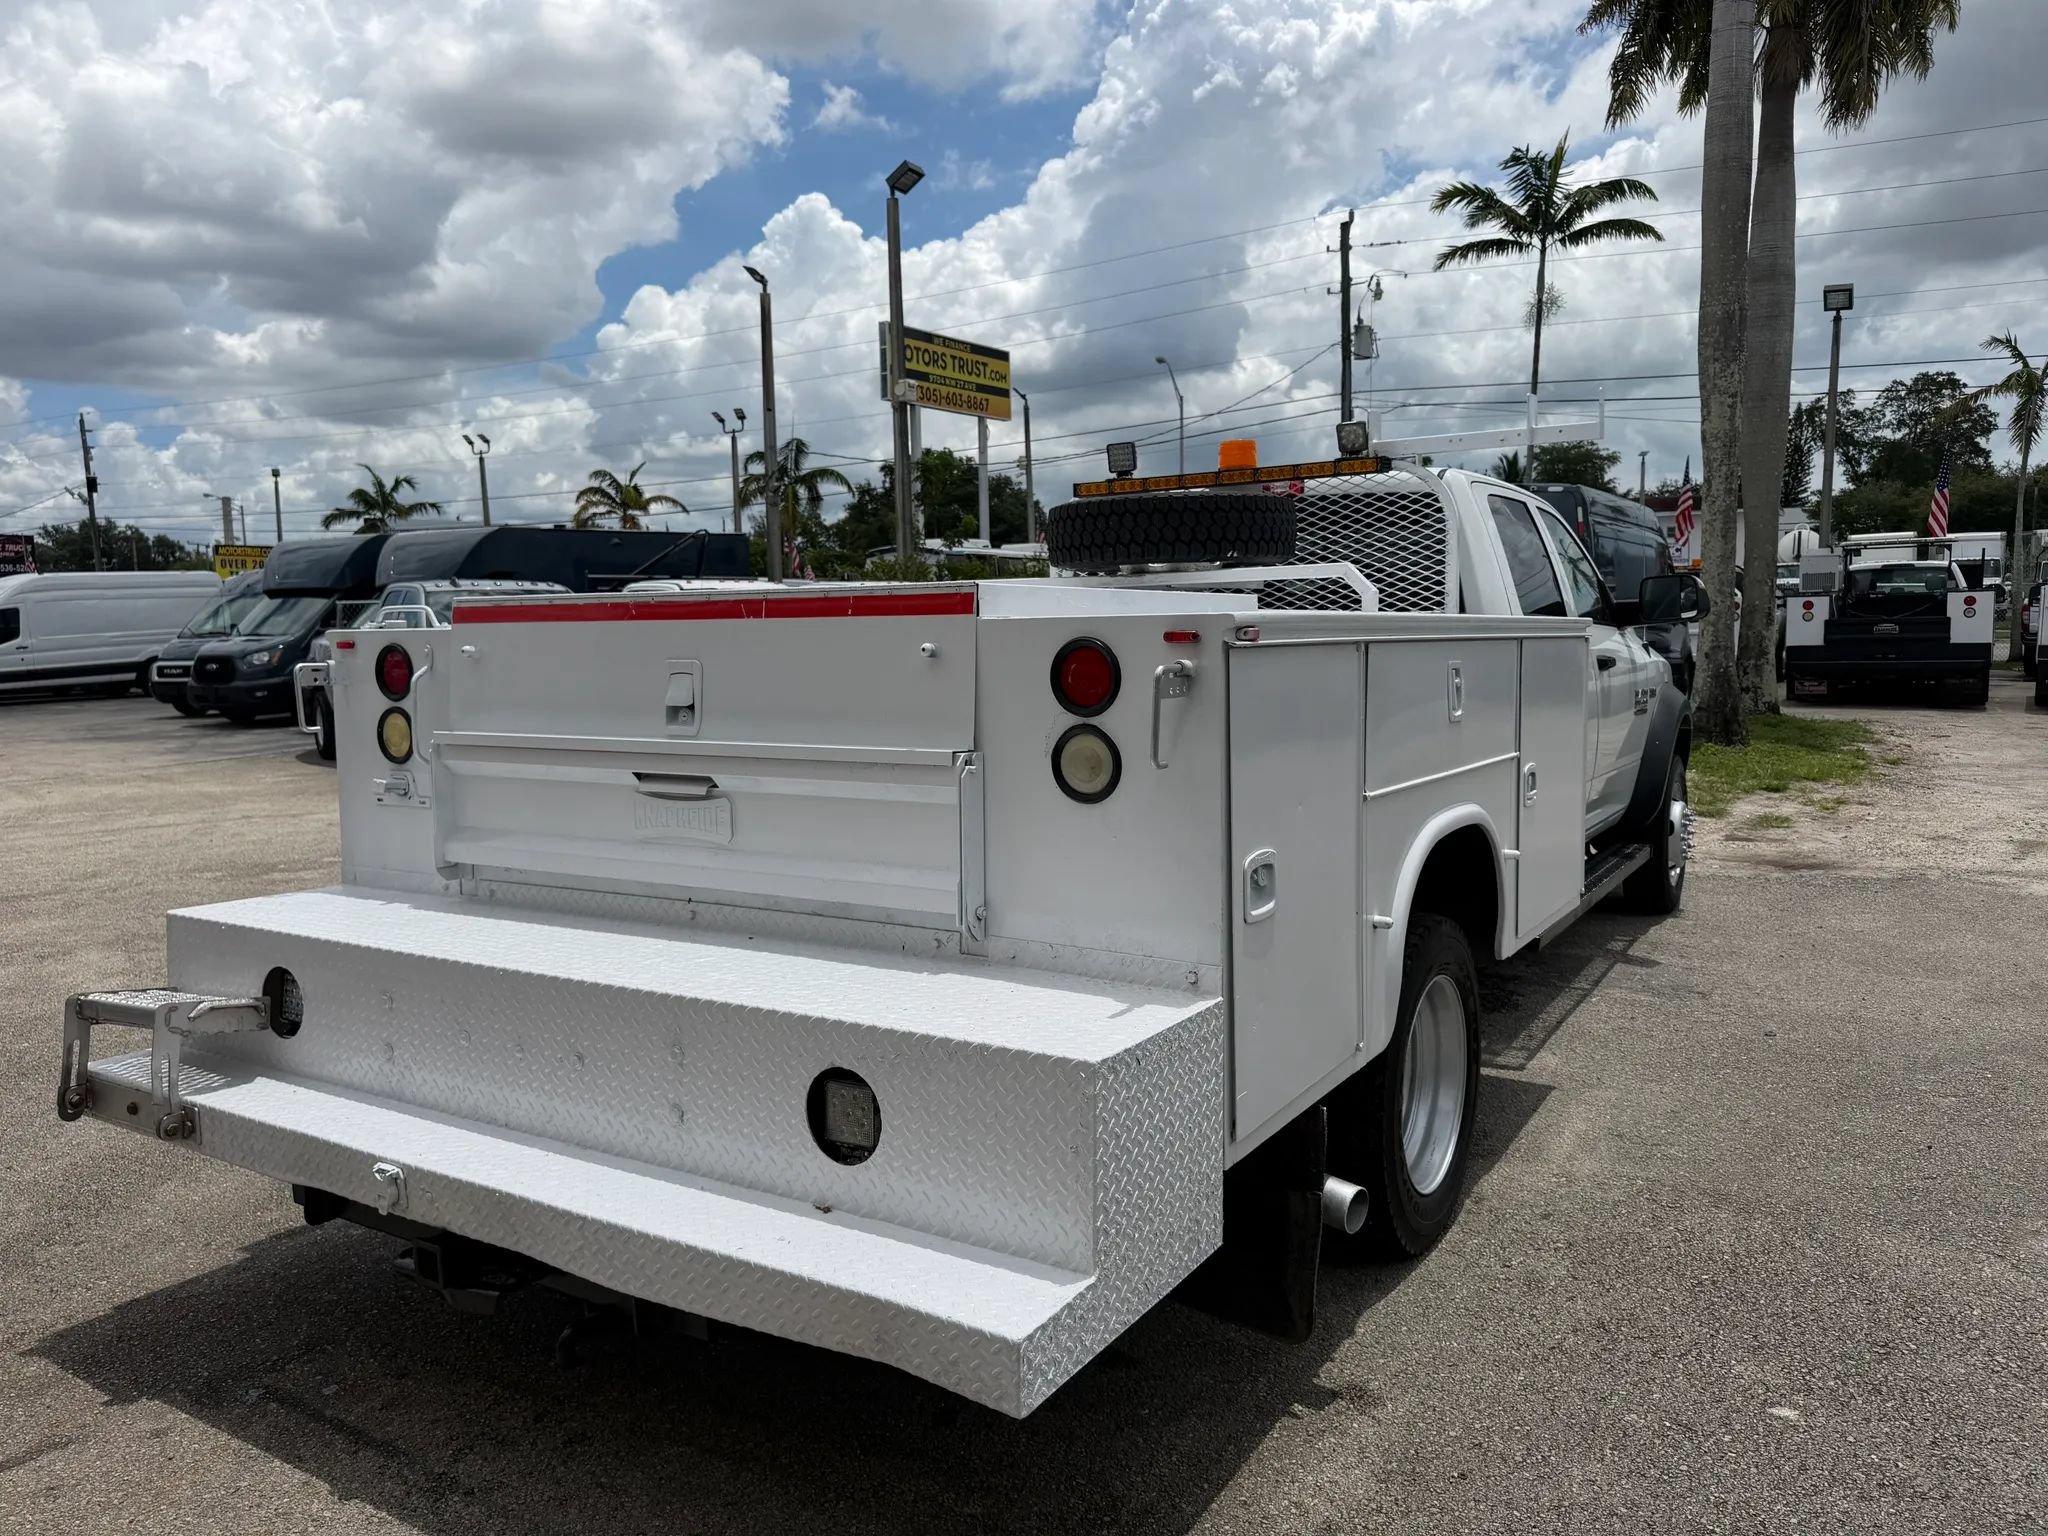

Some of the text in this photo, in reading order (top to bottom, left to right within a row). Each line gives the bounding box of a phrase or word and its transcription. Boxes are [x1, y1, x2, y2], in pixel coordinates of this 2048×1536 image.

[904, 344, 1007, 383] OTORS TRUST.COM
[916, 384, 989, 412] (305)-603-8867
[221, 559, 247, 569] OVER
